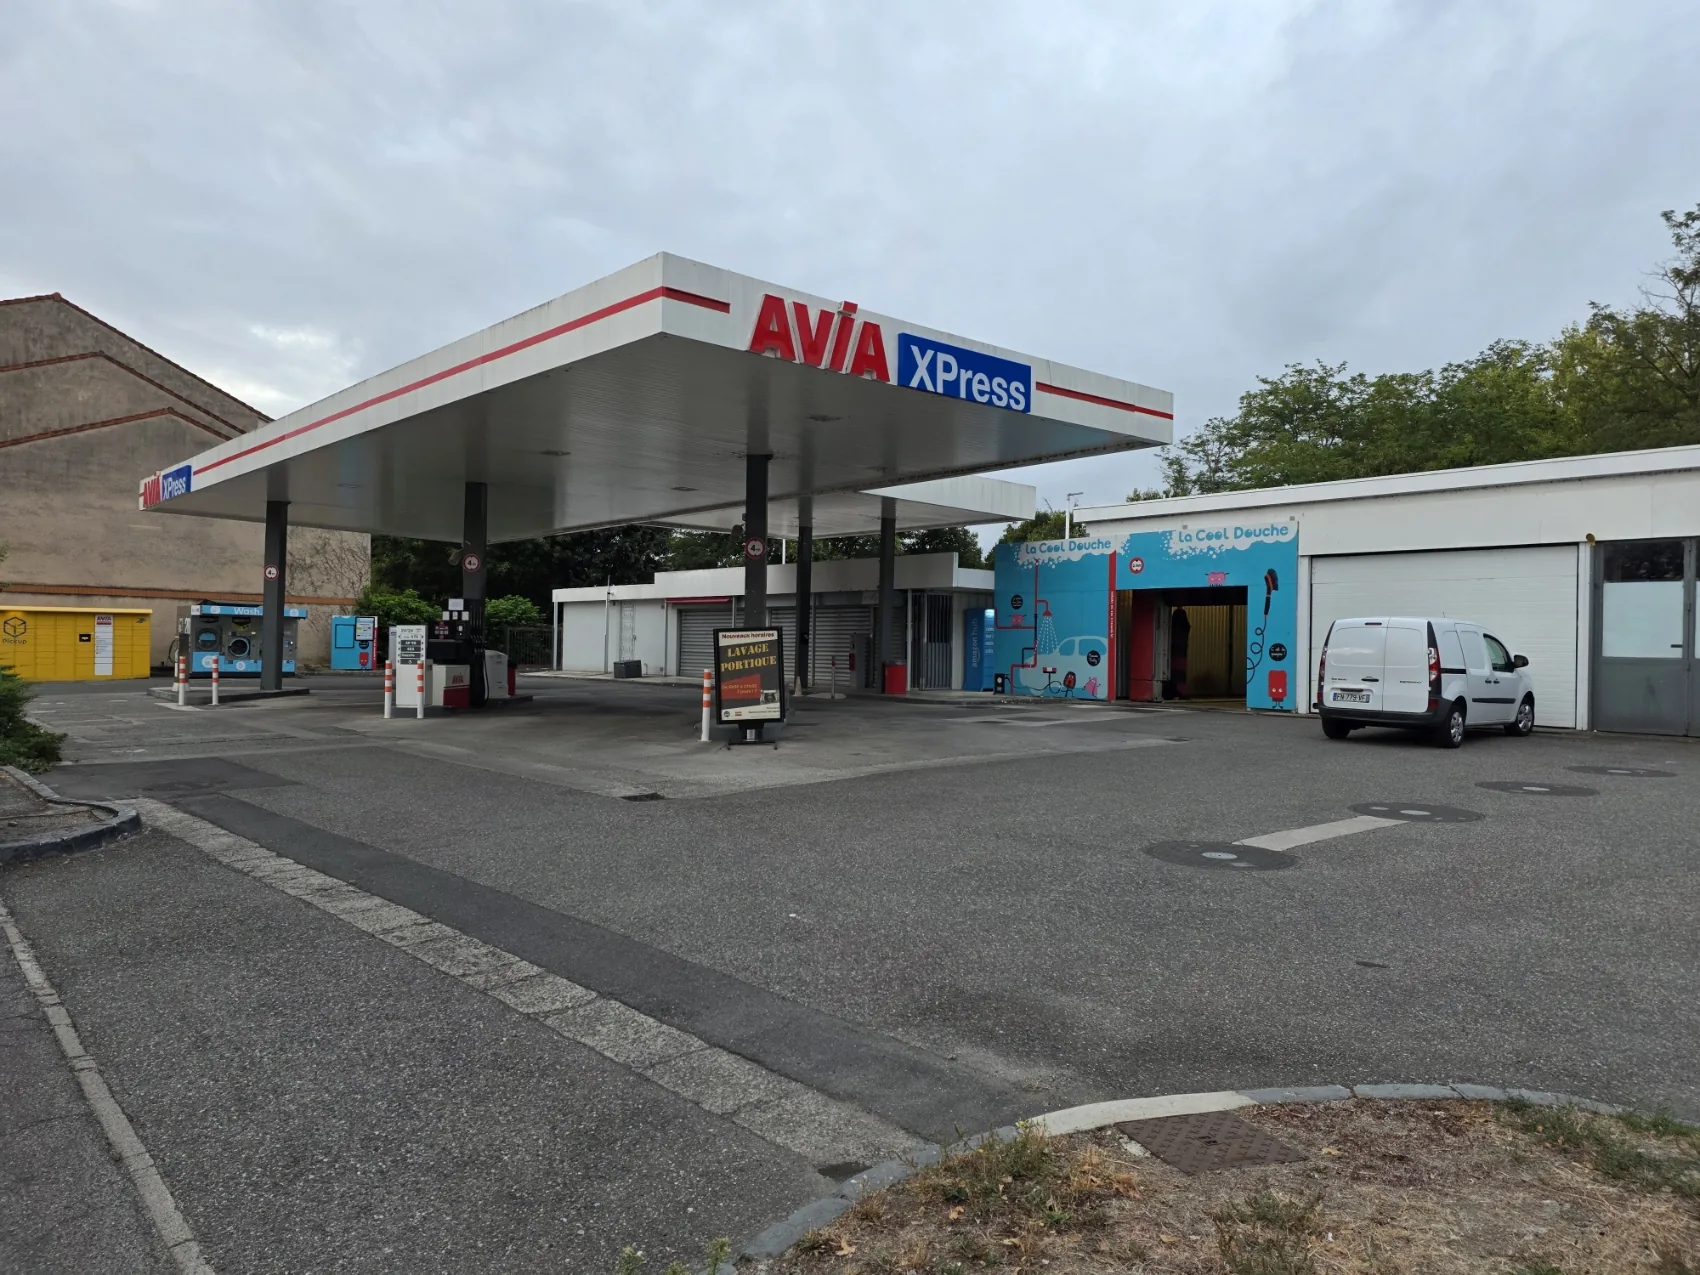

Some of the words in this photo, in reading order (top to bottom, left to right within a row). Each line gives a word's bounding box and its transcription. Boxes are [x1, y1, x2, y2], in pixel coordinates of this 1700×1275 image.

[909, 345, 1026, 412] XPress
[163, 477, 186, 500] XPress
[1178, 531, 1192, 542] La
[1196, 528, 1229, 541] Cool
[1234, 524, 1288, 539] Douche
[1025, 544, 1036, 554] La
[1040, 542, 1065, 553] Cool
[1069, 539, 1111, 551] Douche
[728, 643, 769, 657] LAVAGE
[721, 656, 776, 672] PORTIQUE
